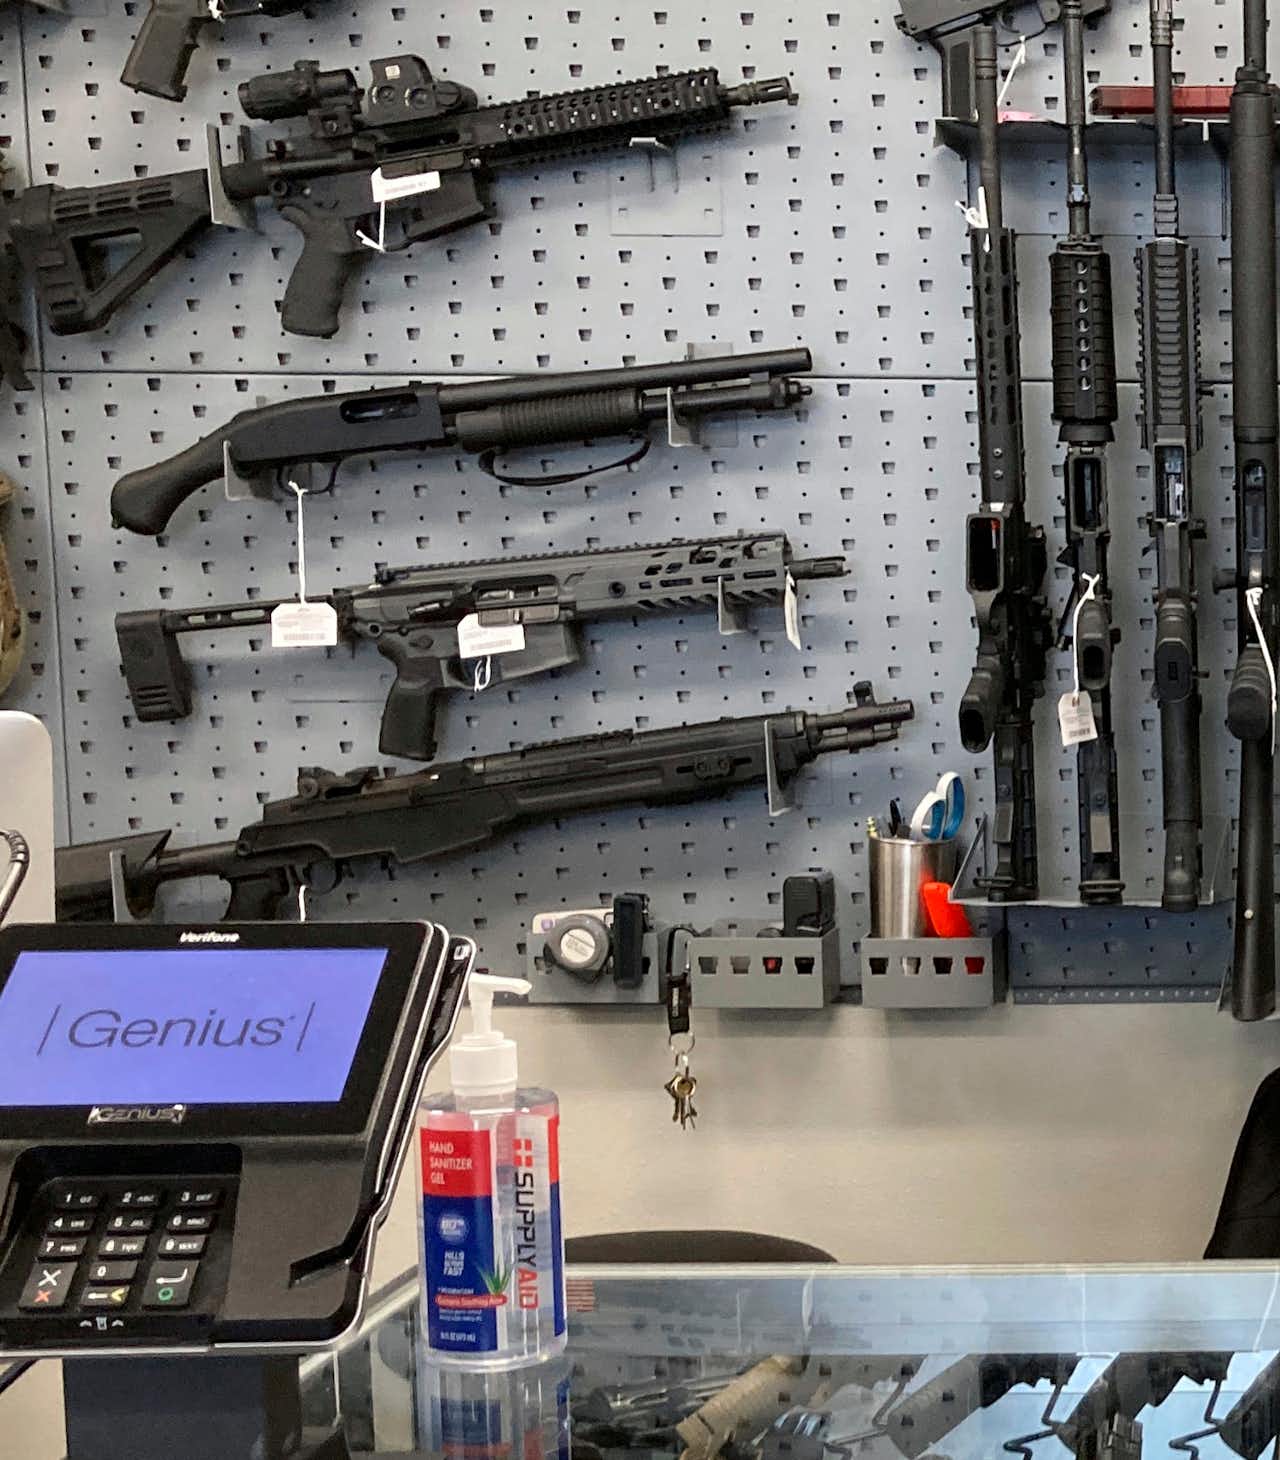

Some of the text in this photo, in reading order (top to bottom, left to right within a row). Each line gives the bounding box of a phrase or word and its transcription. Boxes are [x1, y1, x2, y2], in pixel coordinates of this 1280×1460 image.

[180, 930, 240, 943] Verifone
[428, 1141, 454, 1154] HAND
[429, 1156, 473, 1170] SANITIZER
[430, 1172, 446, 1185] GEL
[65, 1193, 73, 1203] 1
[121, 1192, 133, 1204] 2
[181, 1191, 191, 1202] 3
[54, 1217, 63, 1228] 4
[172, 1215, 182, 1226] 6
[46, 1240, 55, 1252] 7
[165, 1238, 175, 1251] 9
[97, 1265, 107, 1277] 0
